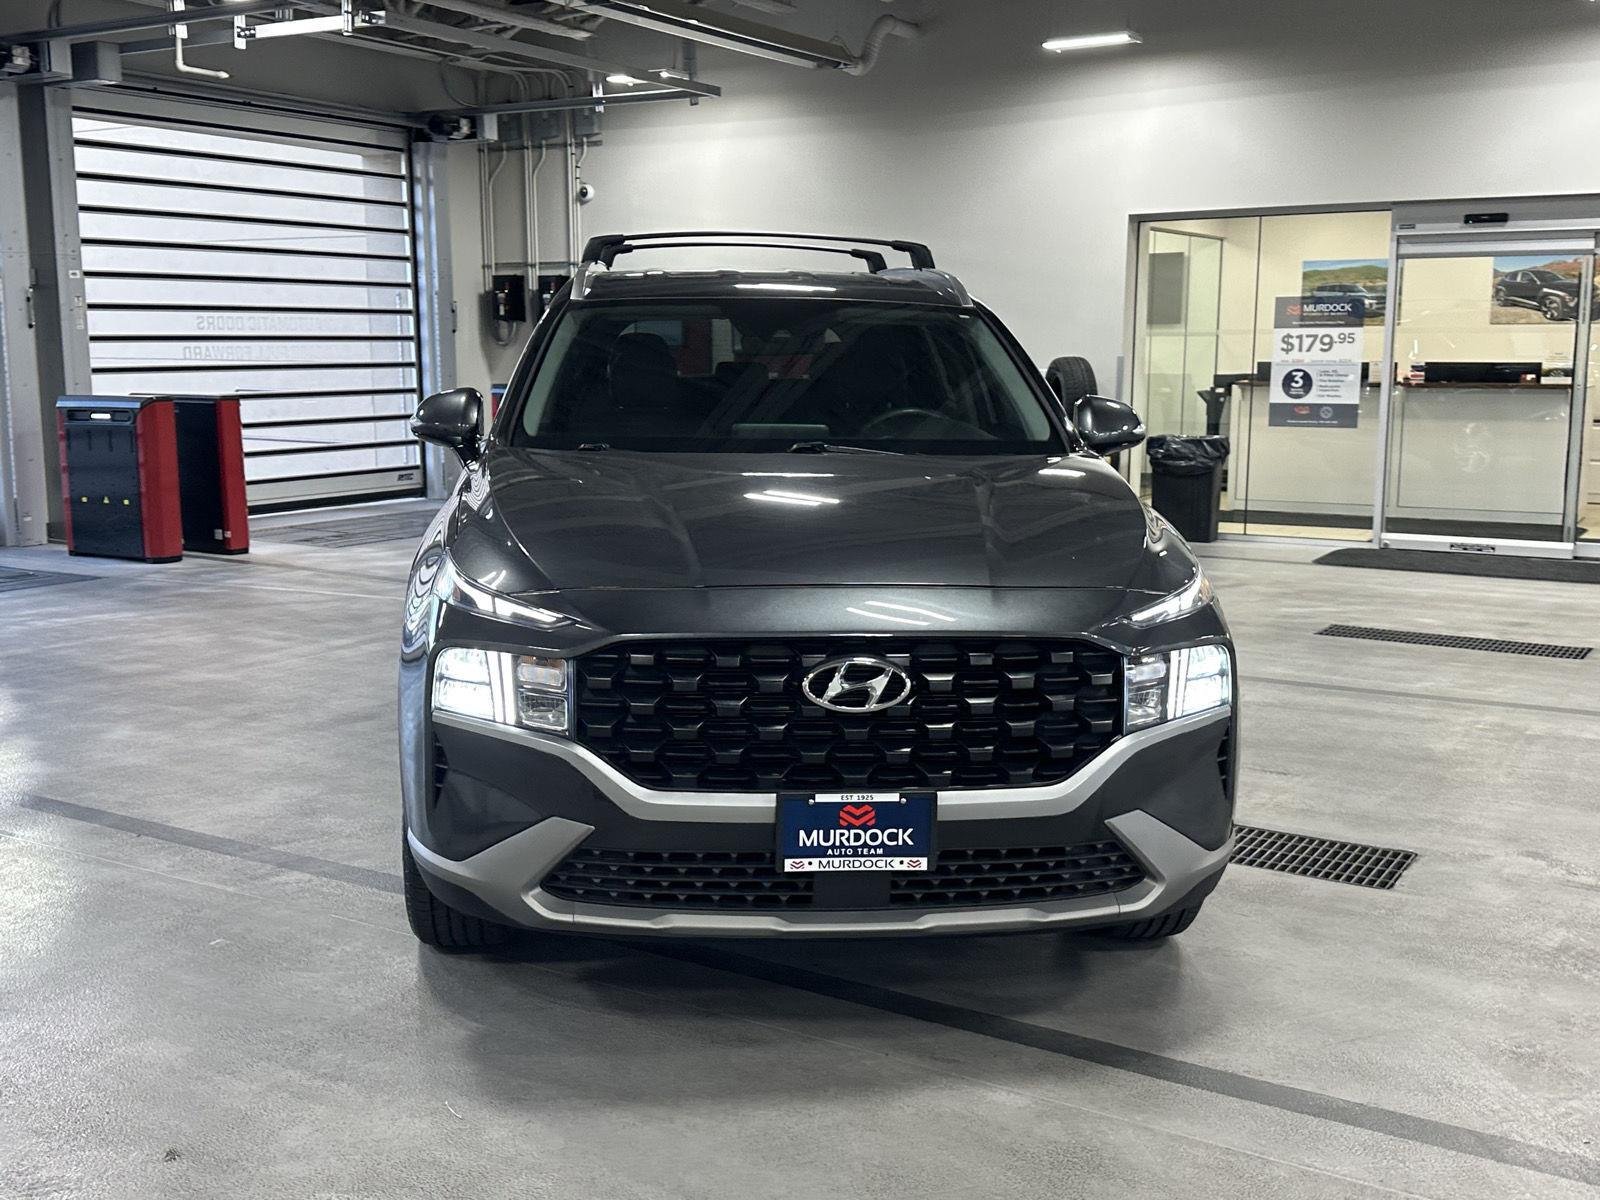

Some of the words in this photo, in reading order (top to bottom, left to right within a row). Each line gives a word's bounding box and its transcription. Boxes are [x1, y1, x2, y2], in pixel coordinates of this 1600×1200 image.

[1303, 303, 1352, 312] MURDOCK
[1290, 371, 1304, 388] 3
[798, 828, 914, 847] MURDOCK
[818, 859, 895, 869] MURDOCK
